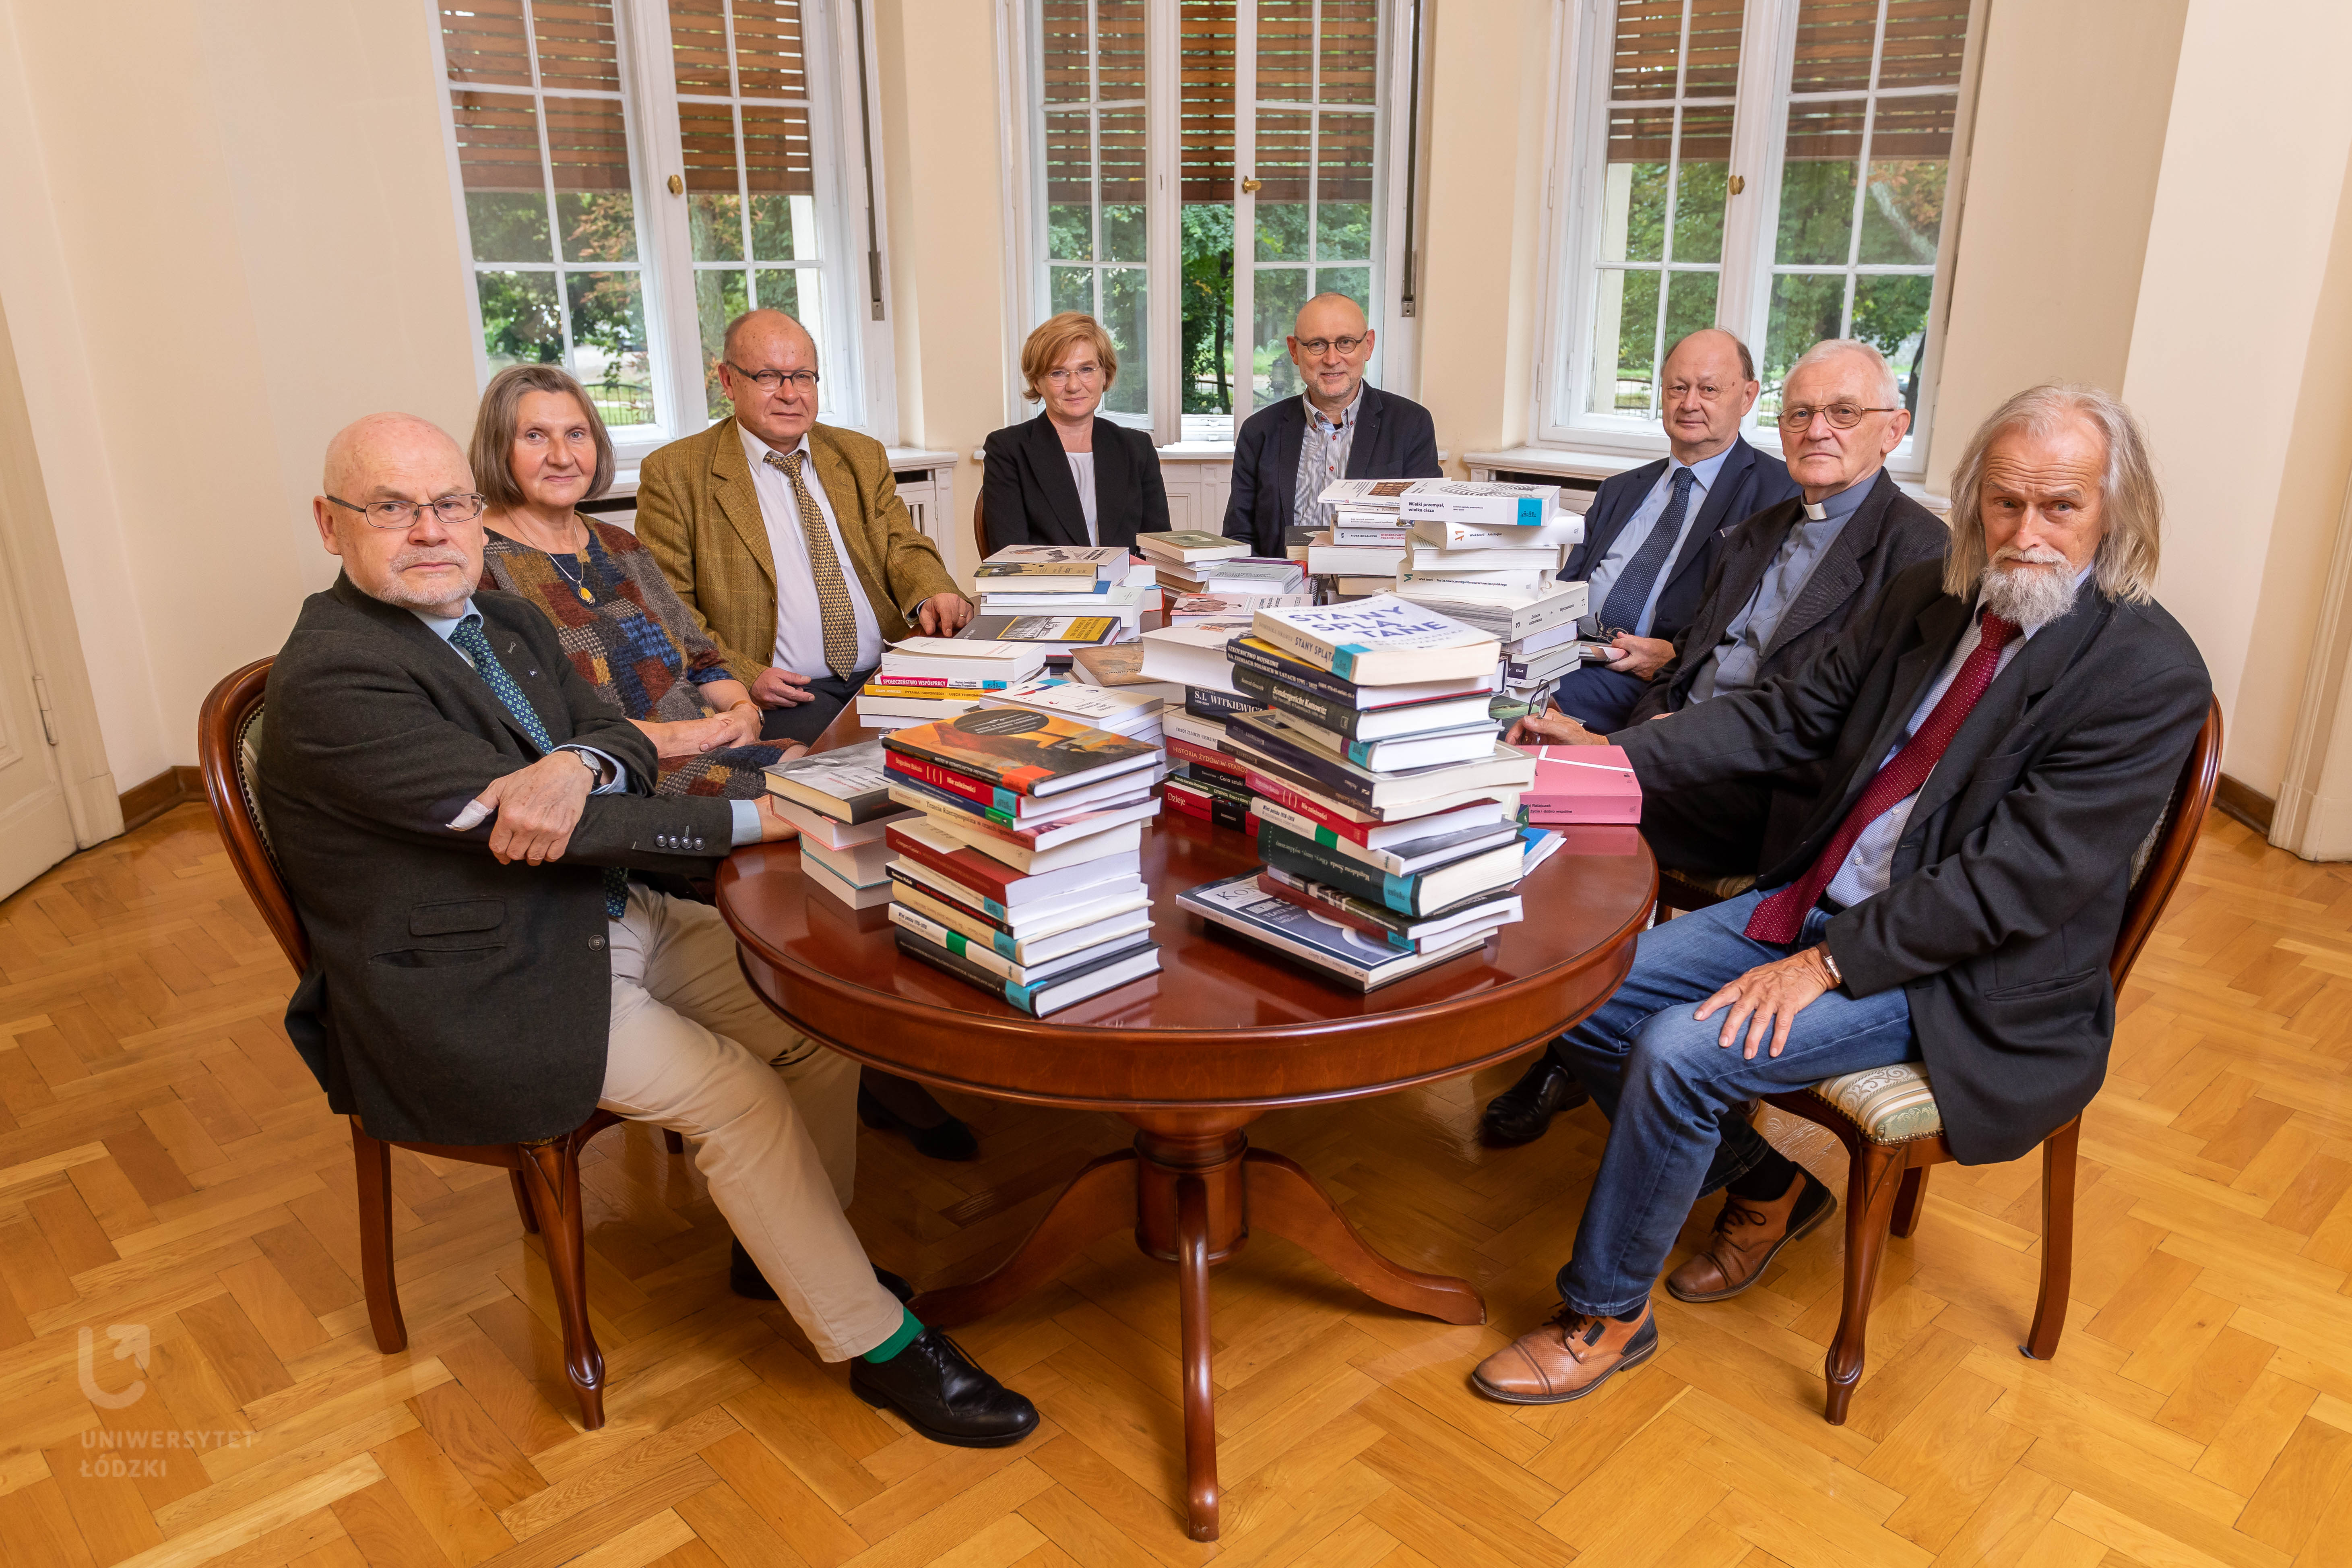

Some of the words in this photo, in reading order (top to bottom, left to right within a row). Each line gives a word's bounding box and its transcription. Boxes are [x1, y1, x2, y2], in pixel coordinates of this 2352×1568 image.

[1288, 605, 1404, 622] STANY
[1559, 603, 1574, 612] Wystawianie
[1353, 621, 1448, 638] TANE
[1295, 637, 1313, 652] STANY
[1228, 647, 1256, 660] SZKOLNICTWO
[1256, 654, 1279, 669] WOJSKOWE
[918, 679, 946, 687] WSPÓŁPRACY
[1195, 690, 1207, 701] S.I.
[1272, 686, 1304, 706] Sondergericht
[1173, 746, 1198, 758] HISTORIA
[1199, 752, 1219, 765] ŻYDÓW
[1220, 775, 1231, 783] Cena
[954, 781, 976, 793] zależności
[1167, 792, 1185, 806] Dzieje
[1301, 801, 1310, 810] Nie
[926, 801, 942, 812] Trzecia
[943, 807, 977, 824] Rzeczpospolita
[982, 821, 996, 831] trzech
[1270, 808, 1280, 816] polska
[891, 871, 904, 882] Tomasz
[904, 915, 913, 923] polska
